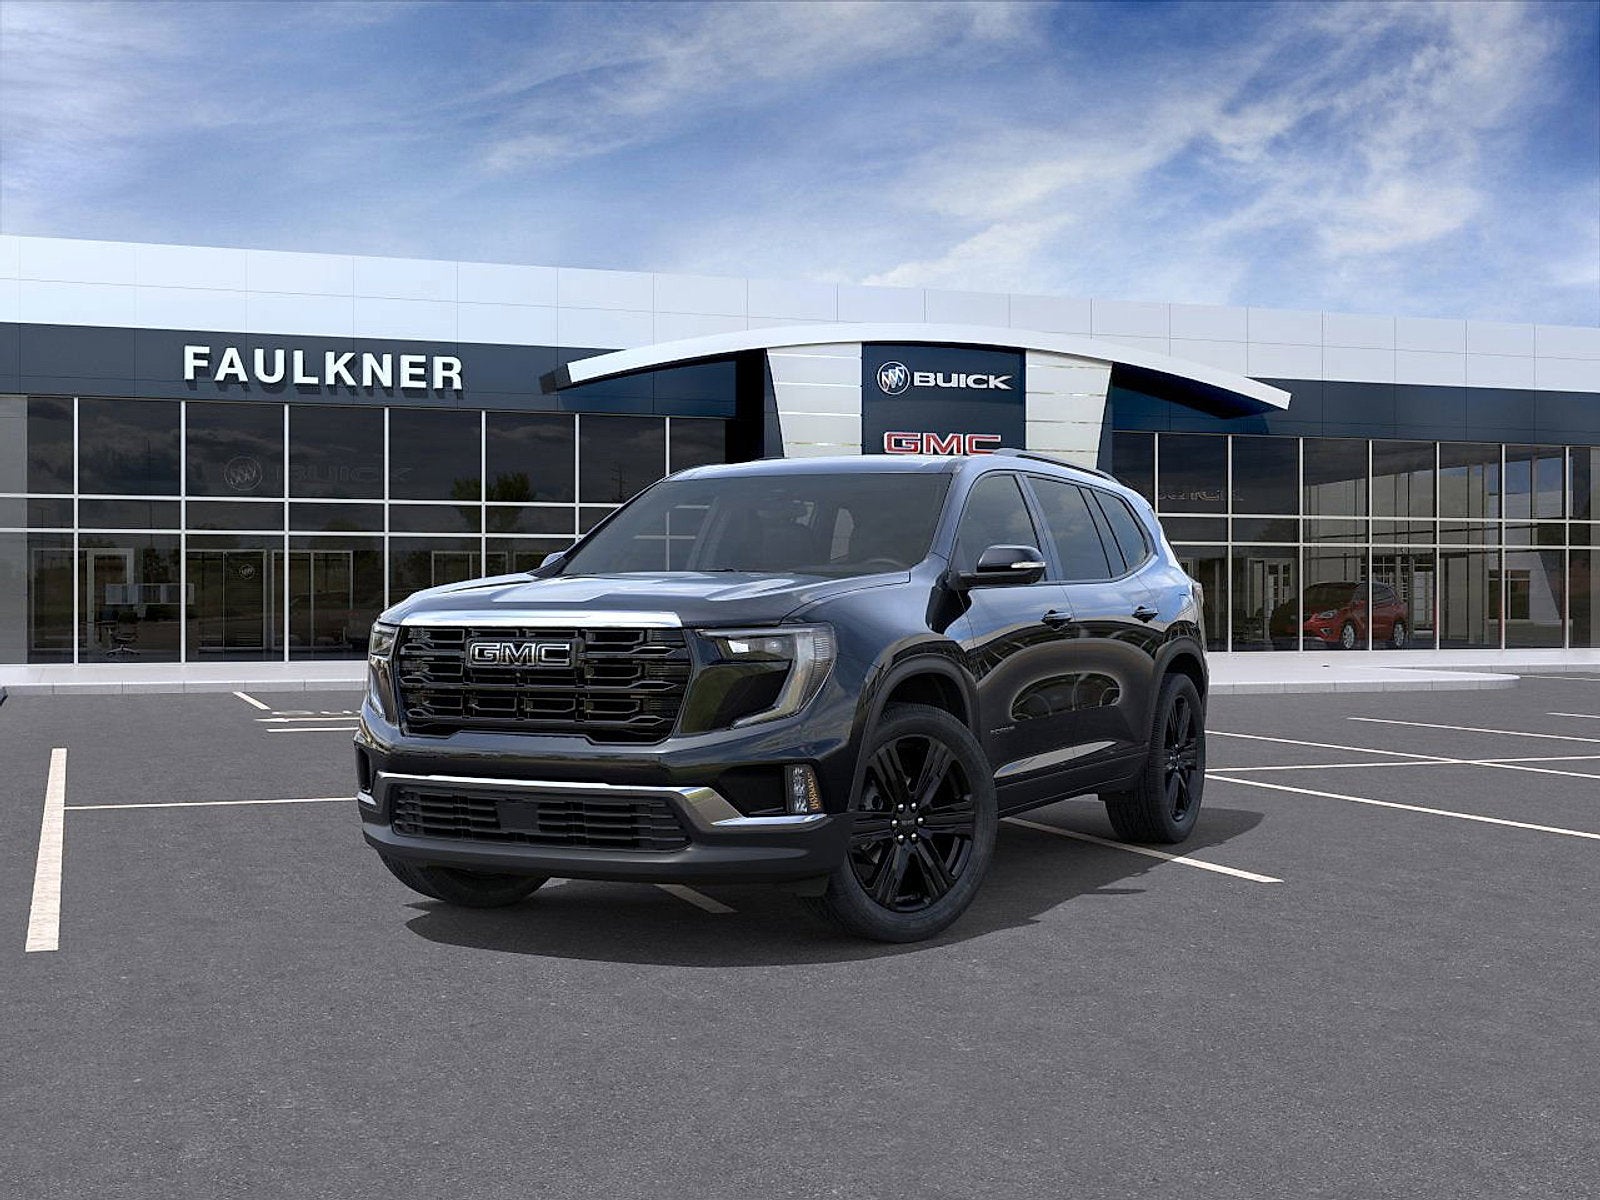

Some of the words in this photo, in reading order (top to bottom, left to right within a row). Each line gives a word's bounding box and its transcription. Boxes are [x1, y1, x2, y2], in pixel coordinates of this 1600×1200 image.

[184, 345, 462, 390] FAULKNER
[913, 371, 1012, 390] BUICK
[884, 432, 1001, 455] GMC
[470, 642, 570, 666] GMC
